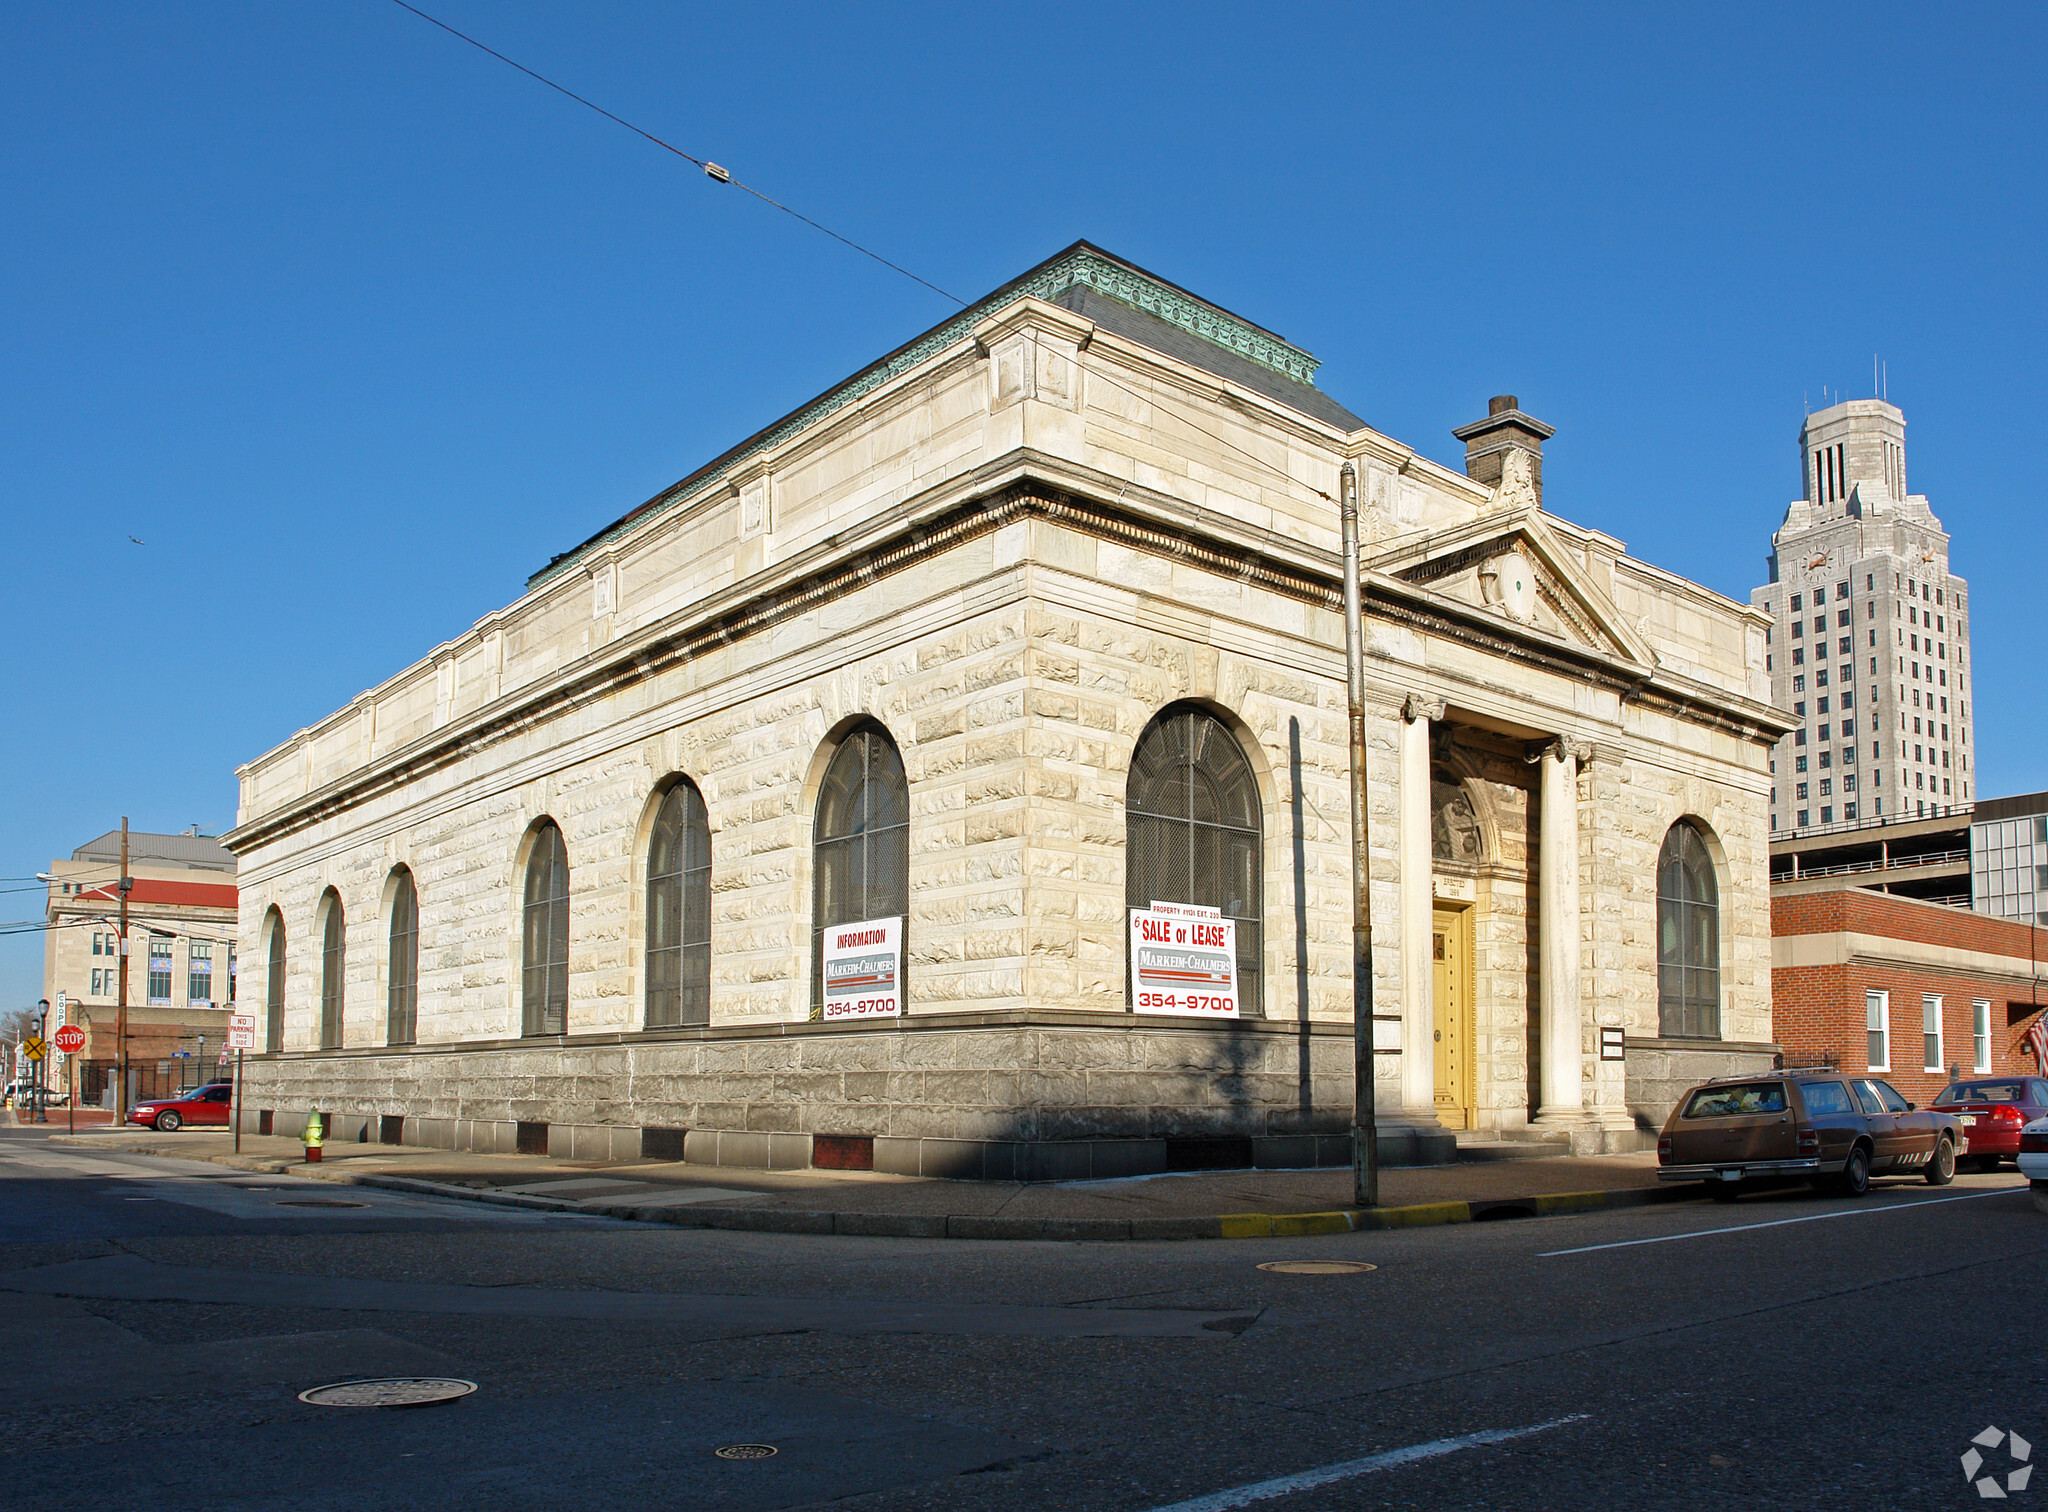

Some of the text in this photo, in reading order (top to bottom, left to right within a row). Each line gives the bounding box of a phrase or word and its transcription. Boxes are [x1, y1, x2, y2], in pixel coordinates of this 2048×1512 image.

[1153, 905, 1180, 915] PROPERTY
[837, 929, 886, 949] INFORMATION
[1142, 919, 1224, 947] SALE or LEASE
[1140, 950, 1230, 972] MARKEIM-CHALMERS
[827, 998, 895, 1016] 354-9700
[1139, 993, 1233, 1011] 354-9700
[230, 1025, 253, 1034] PARKING
[237, 1018, 247, 1026] NO
[56, 1033, 84, 1045] STOP
